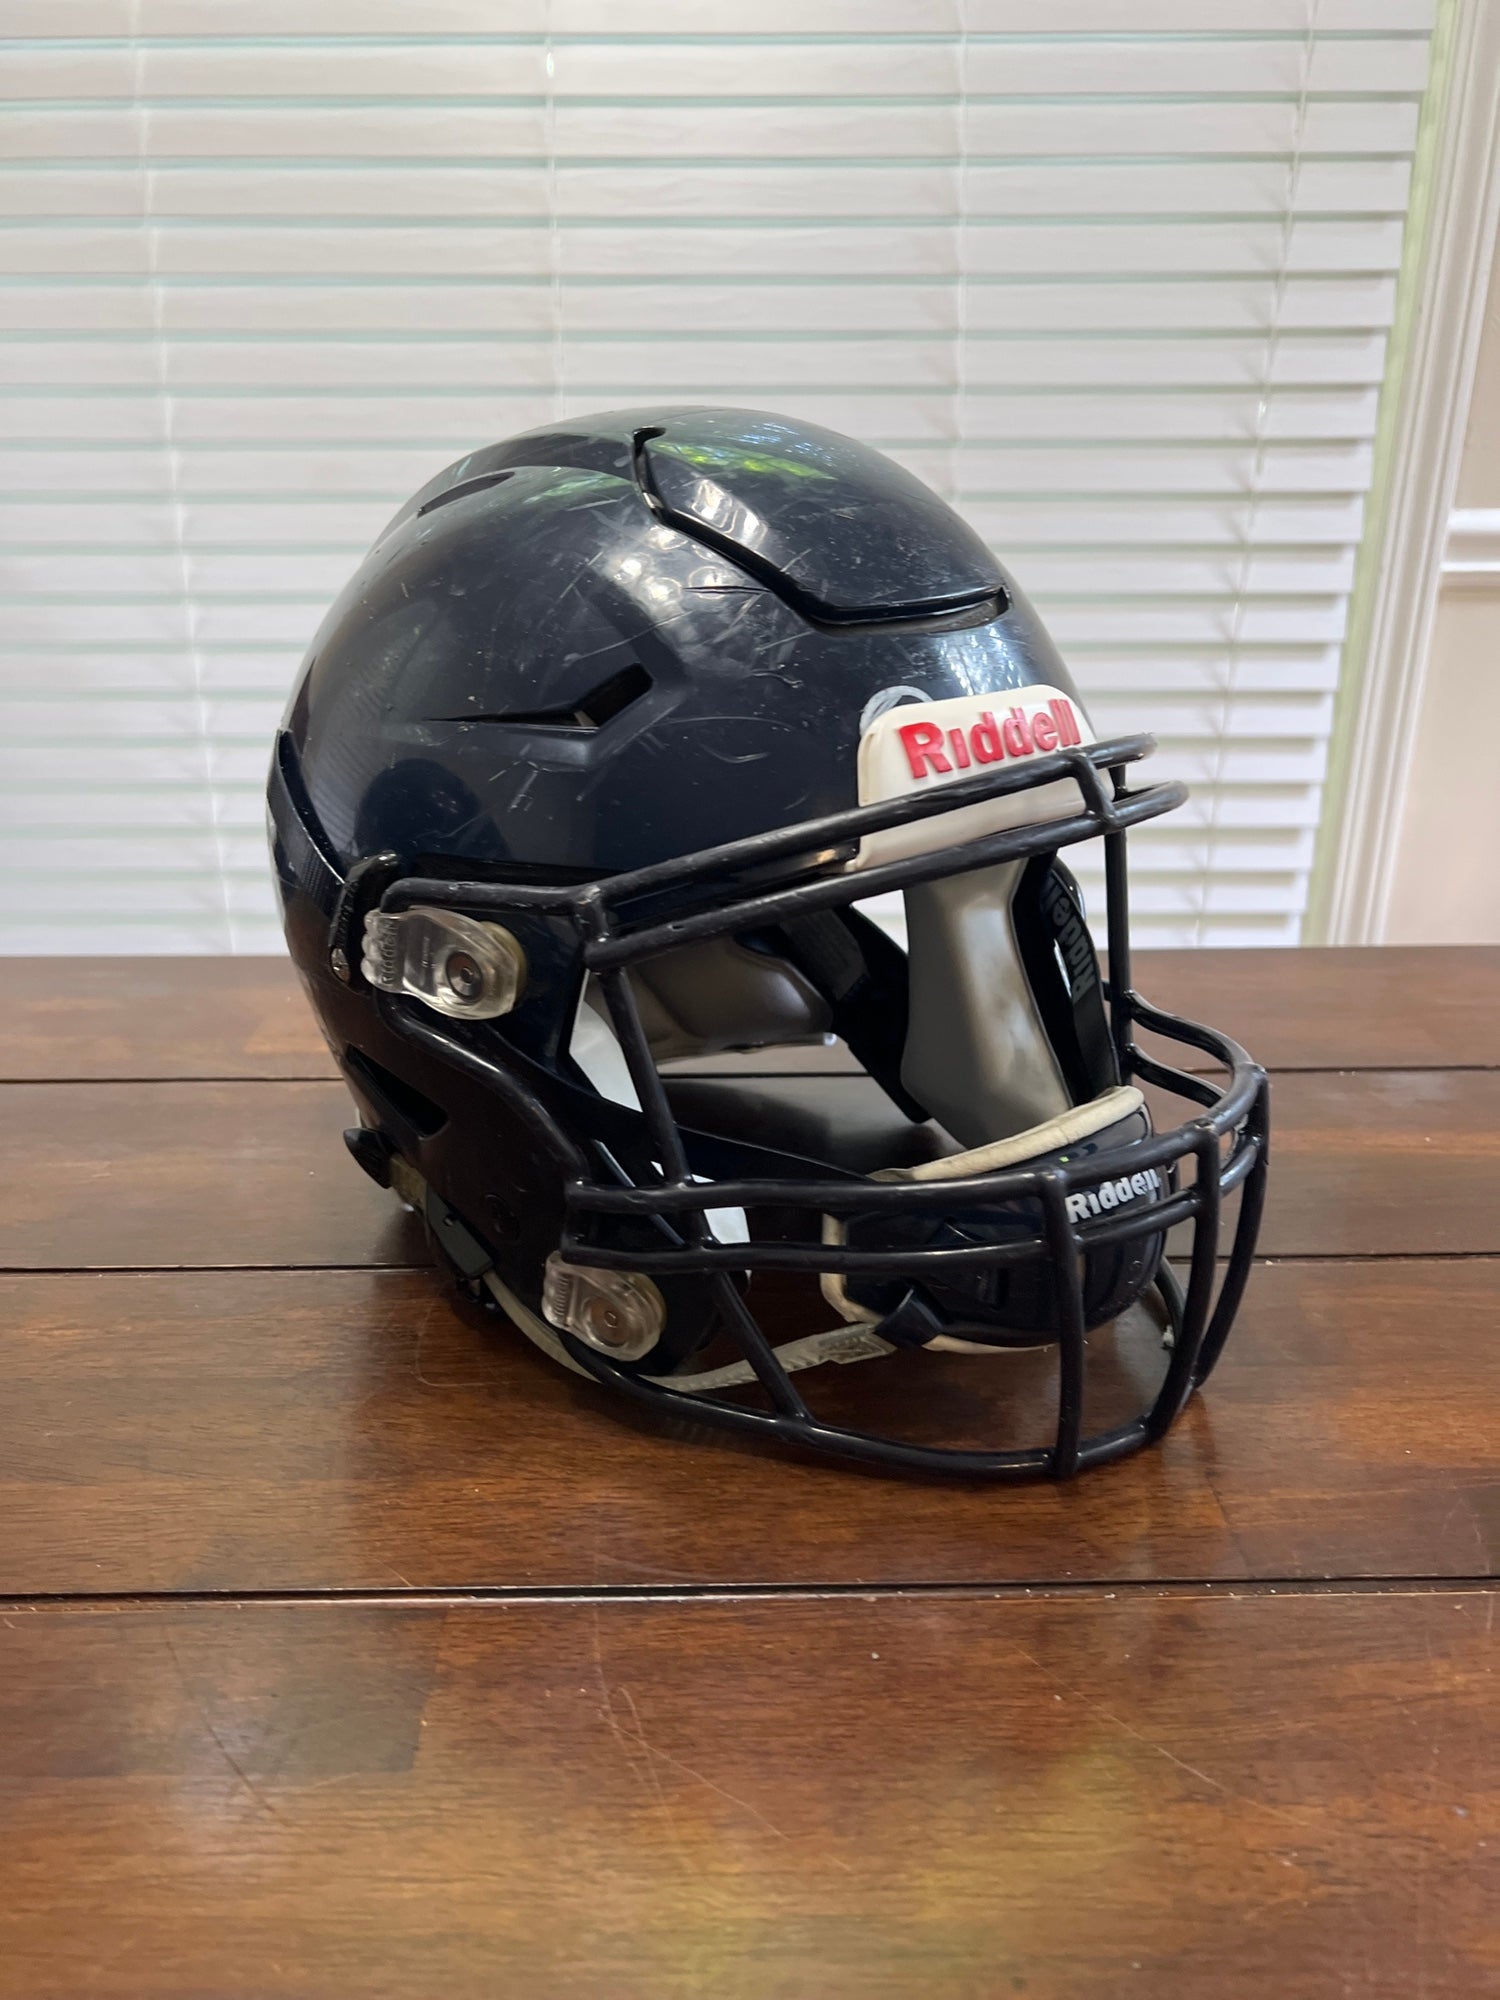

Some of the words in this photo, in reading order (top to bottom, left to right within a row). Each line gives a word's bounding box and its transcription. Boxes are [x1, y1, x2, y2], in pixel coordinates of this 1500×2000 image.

[897, 698, 1082, 780] Riddell
[1040, 874, 1096, 1006] Riddell
[1065, 1169, 1159, 1223] Riddell
